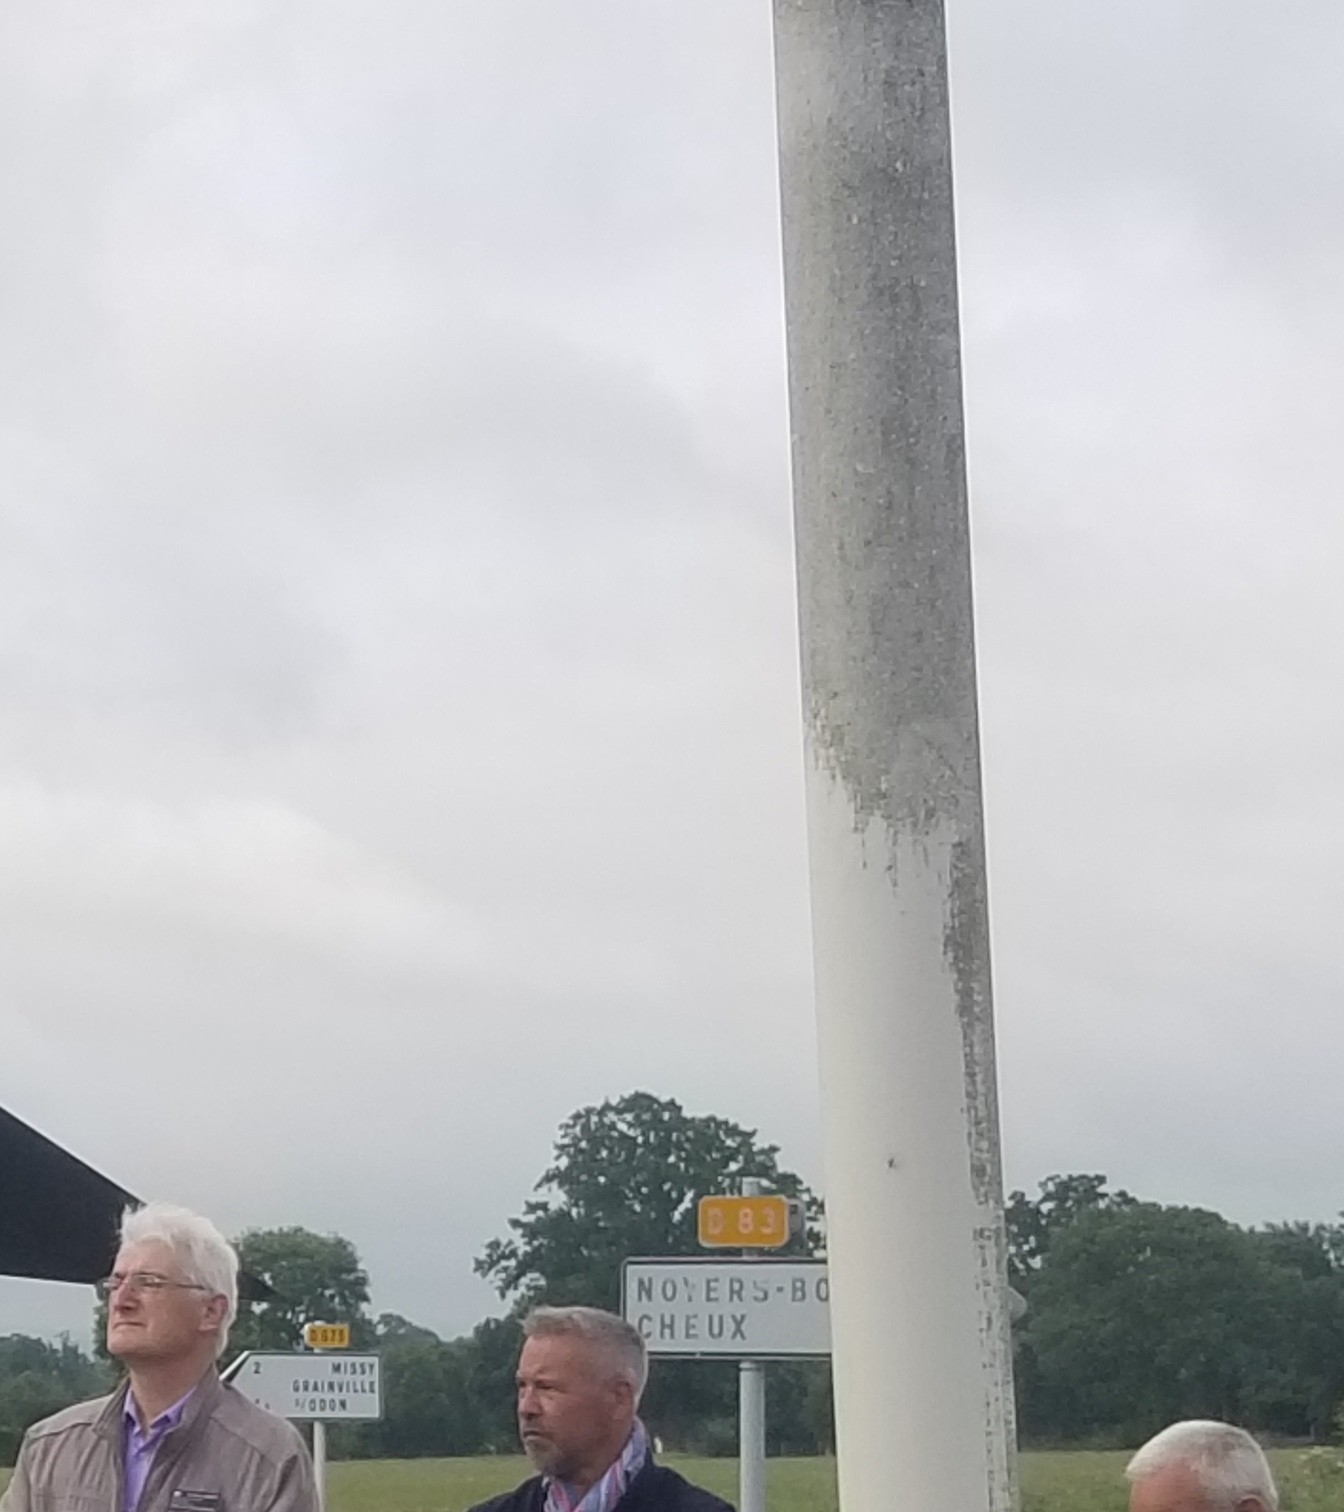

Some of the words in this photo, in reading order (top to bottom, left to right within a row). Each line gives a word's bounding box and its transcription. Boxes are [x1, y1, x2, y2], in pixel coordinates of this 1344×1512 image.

[706, 1207, 725, 1235] D
[737, 1206, 776, 1235] 83
[637, 1313, 748, 1341] CHEUX
[253, 1362, 261, 1375] 2
[331, 1362, 377, 1376] MISSY
[292, 1380, 376, 1394] GRAINVILLE
